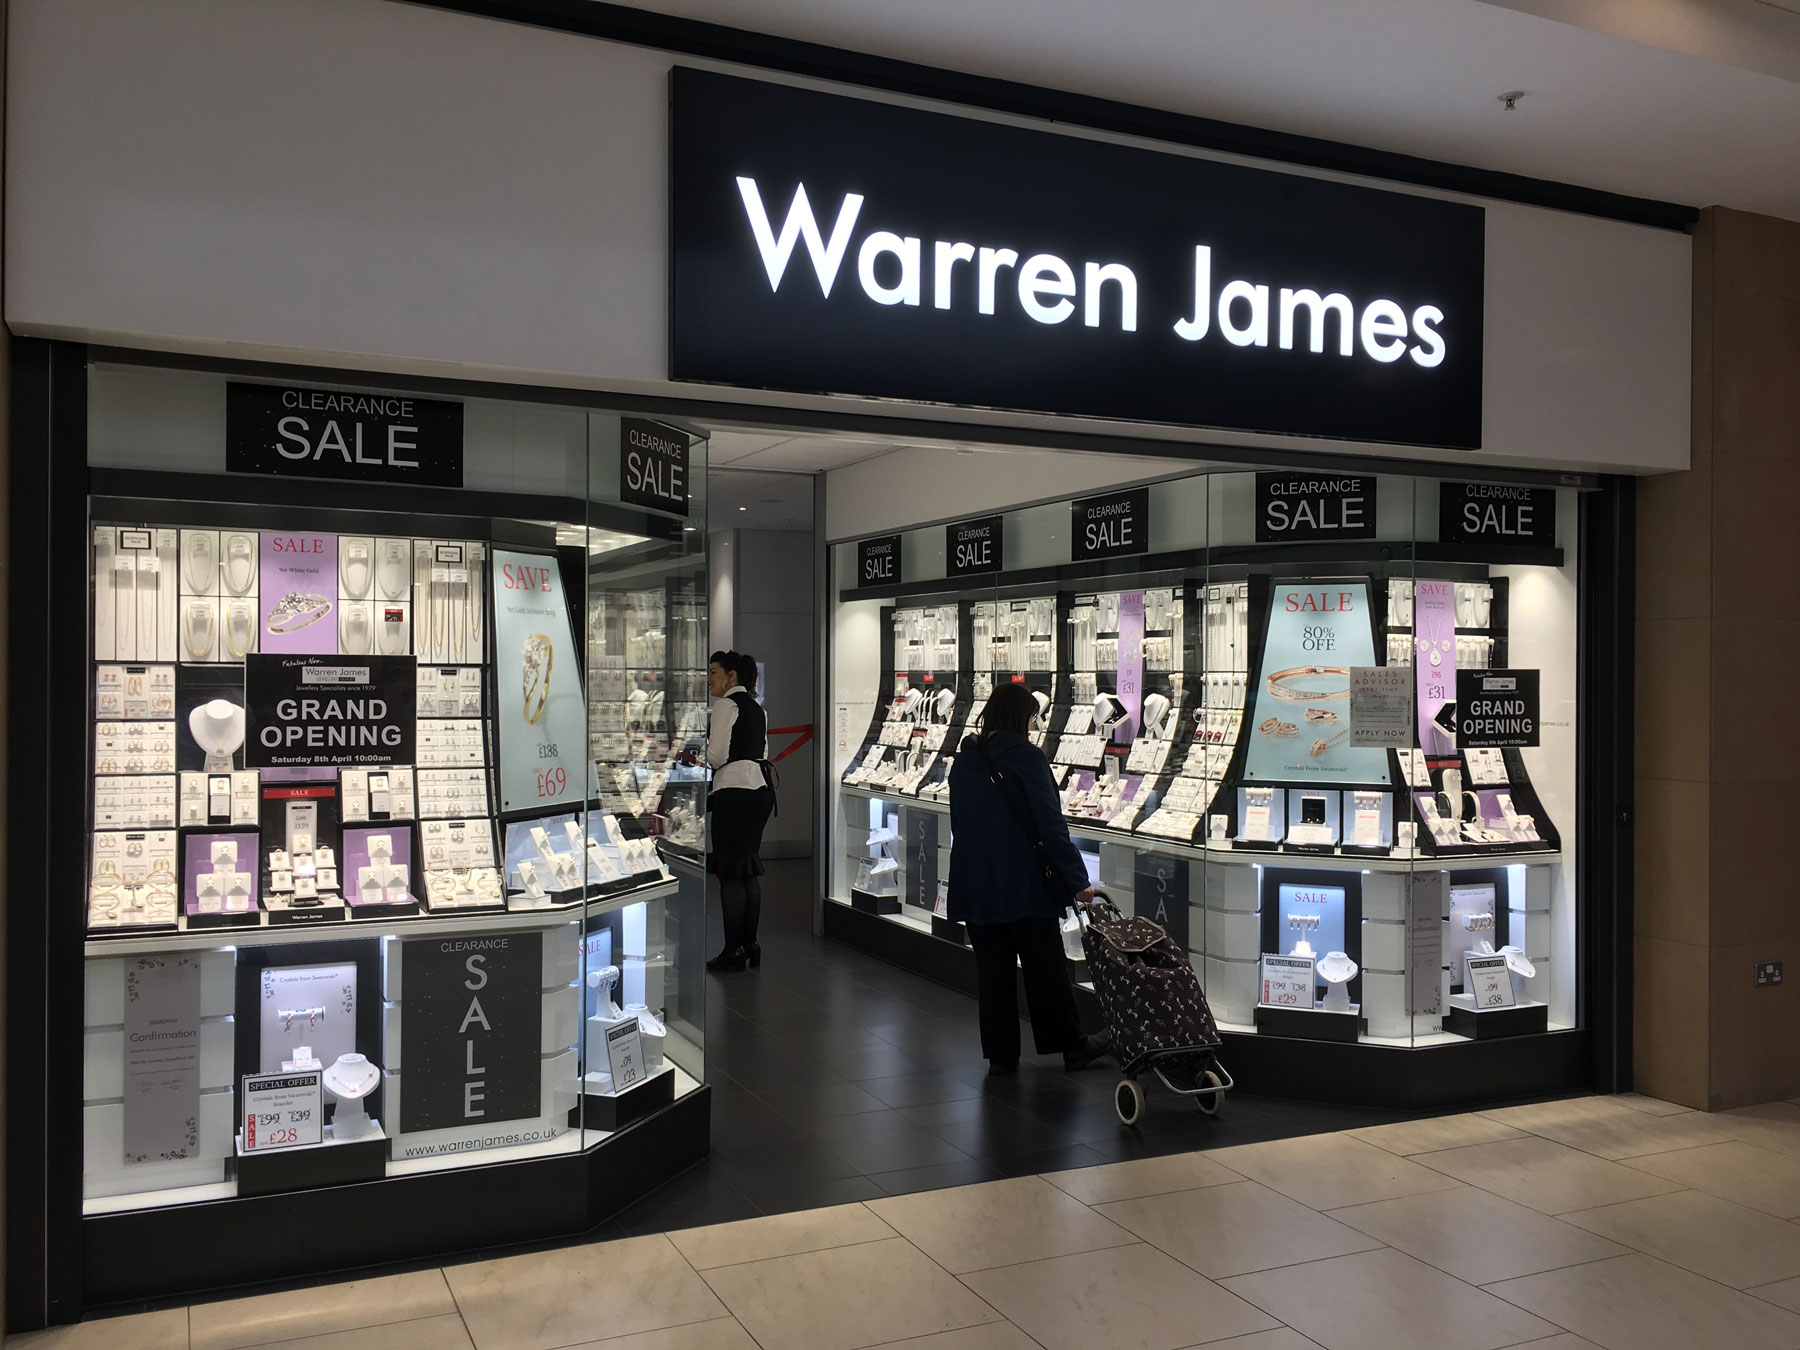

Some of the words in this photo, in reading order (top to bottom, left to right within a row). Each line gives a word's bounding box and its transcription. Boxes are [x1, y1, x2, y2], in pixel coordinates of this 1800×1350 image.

[736, 176, 1137, 332] Warren
[1173, 244, 1446, 368] James
[282, 391, 414, 418] CLEARANCE
[275, 416, 420, 468] SALE
[629, 429, 682, 459] CLEARANCE
[627, 451, 683, 502] SALE
[1270, 479, 1361, 496] CLEARANCE
[1466, 484, 1531, 501] CLEARANCE
[1087, 501, 1131, 520] CLEARANCE
[1266, 497, 1365, 532] SALE
[1463, 502, 1534, 536] SALE
[957, 526, 990, 542] CLEARANCE
[1085, 517, 1133, 551] SALE
[272, 537, 324, 554] SALE
[866, 543, 892, 557] CLEARANCE
[956, 541, 992, 568] SALE
[865, 556, 893, 580] SALE
[502, 563, 553, 593] SAVE
[1421, 583, 1448, 596] SAVE
[1123, 593, 1142, 605] SAVE
[1285, 592, 1354, 613] SALE
[1302, 625, 1336, 639] 80%
[1302, 638, 1337, 651] OFF
[305, 668, 338, 677] Warren
[339, 668, 367, 677] James
[1363, 670, 1397, 678] SALES
[1123, 682, 1135, 694] £31
[1428, 685, 1446, 699] £31
[276, 699, 388, 721] GRAND
[1470, 700, 1525, 716] GRAND
[1463, 718, 1533, 735] OPENING
[260, 725, 401, 747] OPENING
[271, 755, 312, 764] Saturday
[331, 755, 352, 763] April
[354, 754, 392, 762] 10:00am
[536, 767, 566, 798] £69
[918, 820, 926, 905] SALE
[1294, 891, 1328, 904] SALE
[440, 938, 509, 953] CLEARANCE
[1266, 959, 1289, 967] SPECIAL
[280, 975, 299, 983] Crystals
[1278, 993, 1297, 1005] £29
[1488, 994, 1503, 1006] £38
[129, 1029, 197, 1042] Confirmation
[458, 954, 492, 1118] SALE
[250, 1080, 286, 1091] SPECIAL
[287, 1077, 316, 1087] OFFER
[260, 1112, 281, 1126] £99
[290, 1108, 312, 1123] £39
[269, 1127, 298, 1145] £28
[404, 1127, 557, 1157] www.warrenjames.co.uk
